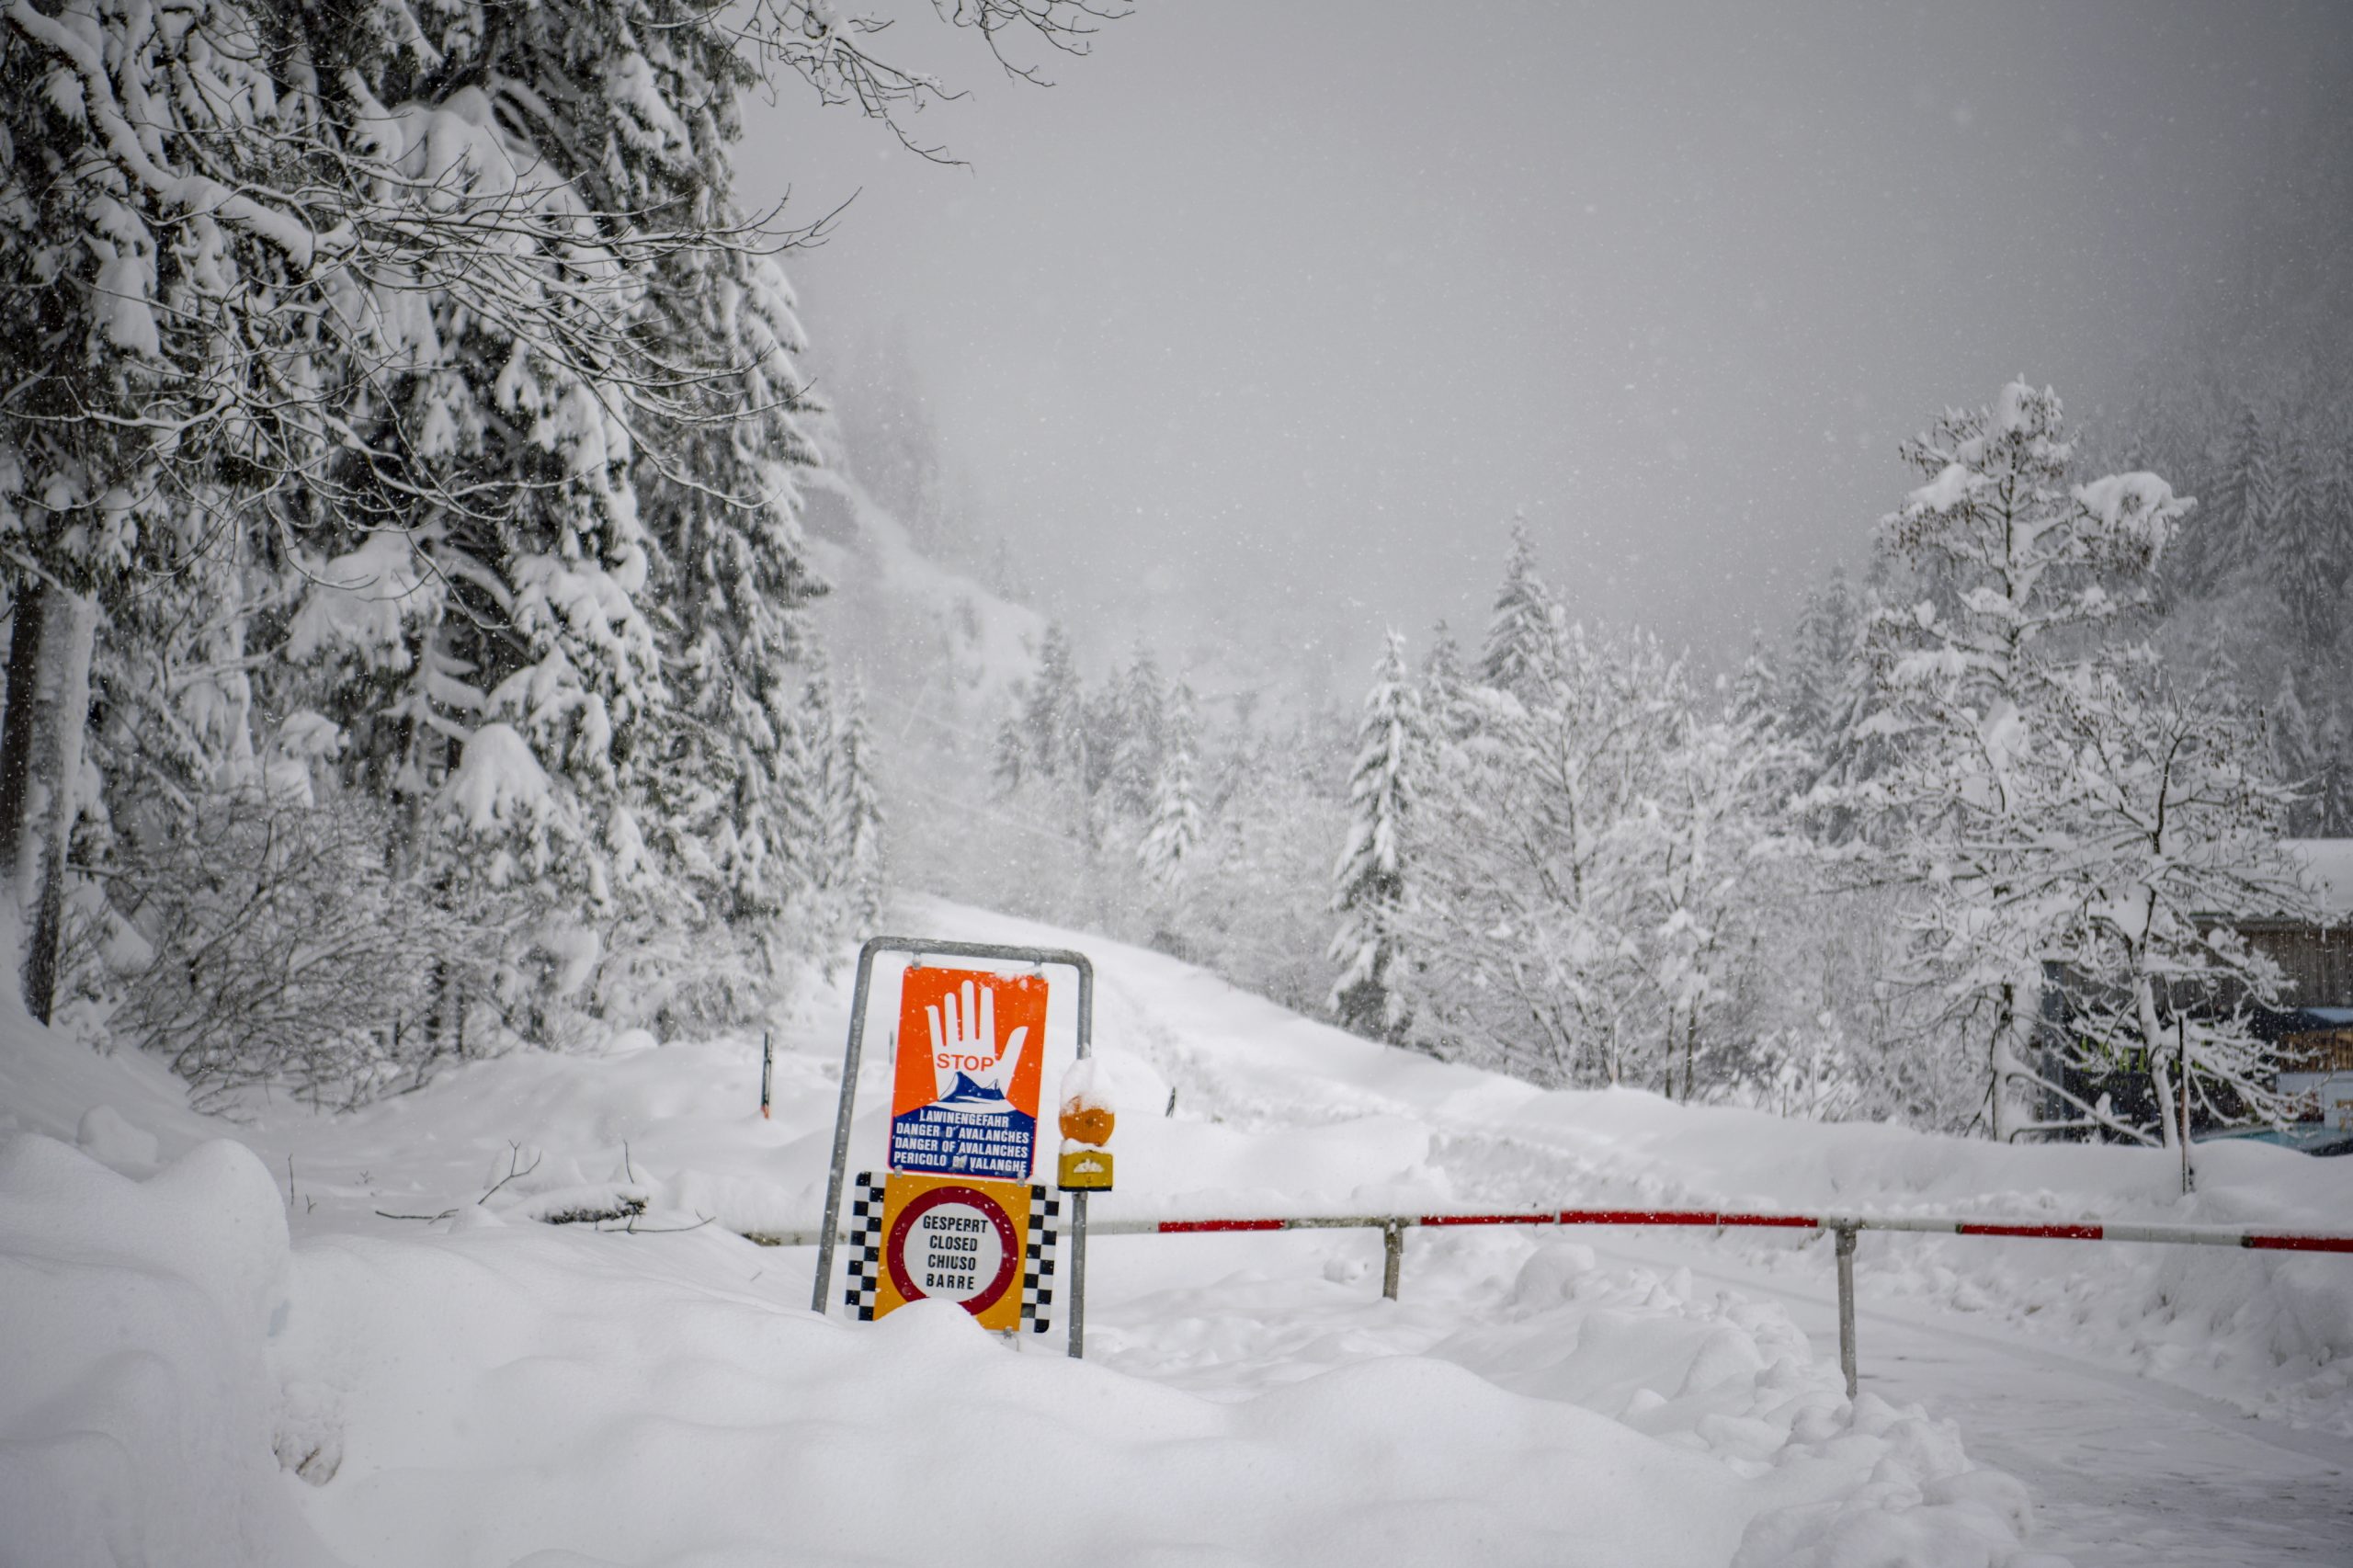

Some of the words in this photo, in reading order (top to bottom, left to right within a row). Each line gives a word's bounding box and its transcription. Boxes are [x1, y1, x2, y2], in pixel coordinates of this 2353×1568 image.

[937, 1053, 994, 1072] STOP
[919, 1109, 1009, 1128] LAWINENGEFAHR
[896, 1122, 940, 1137] DANGER
[894, 1137, 938, 1152] DANGER
[941, 1140, 956, 1153] OF
[958, 1142, 1029, 1158] AVALANCHES
[893, 1151, 947, 1166] PERICOLO
[952, 1155, 966, 1168] D
[970, 1157, 1027, 1173] VALANGHE
[923, 1215, 988, 1233] GESPERRT
[929, 1234, 978, 1252] CLOSED
[927, 1254, 976, 1271] CHIUSO
[926, 1273, 974, 1290] BARRE
